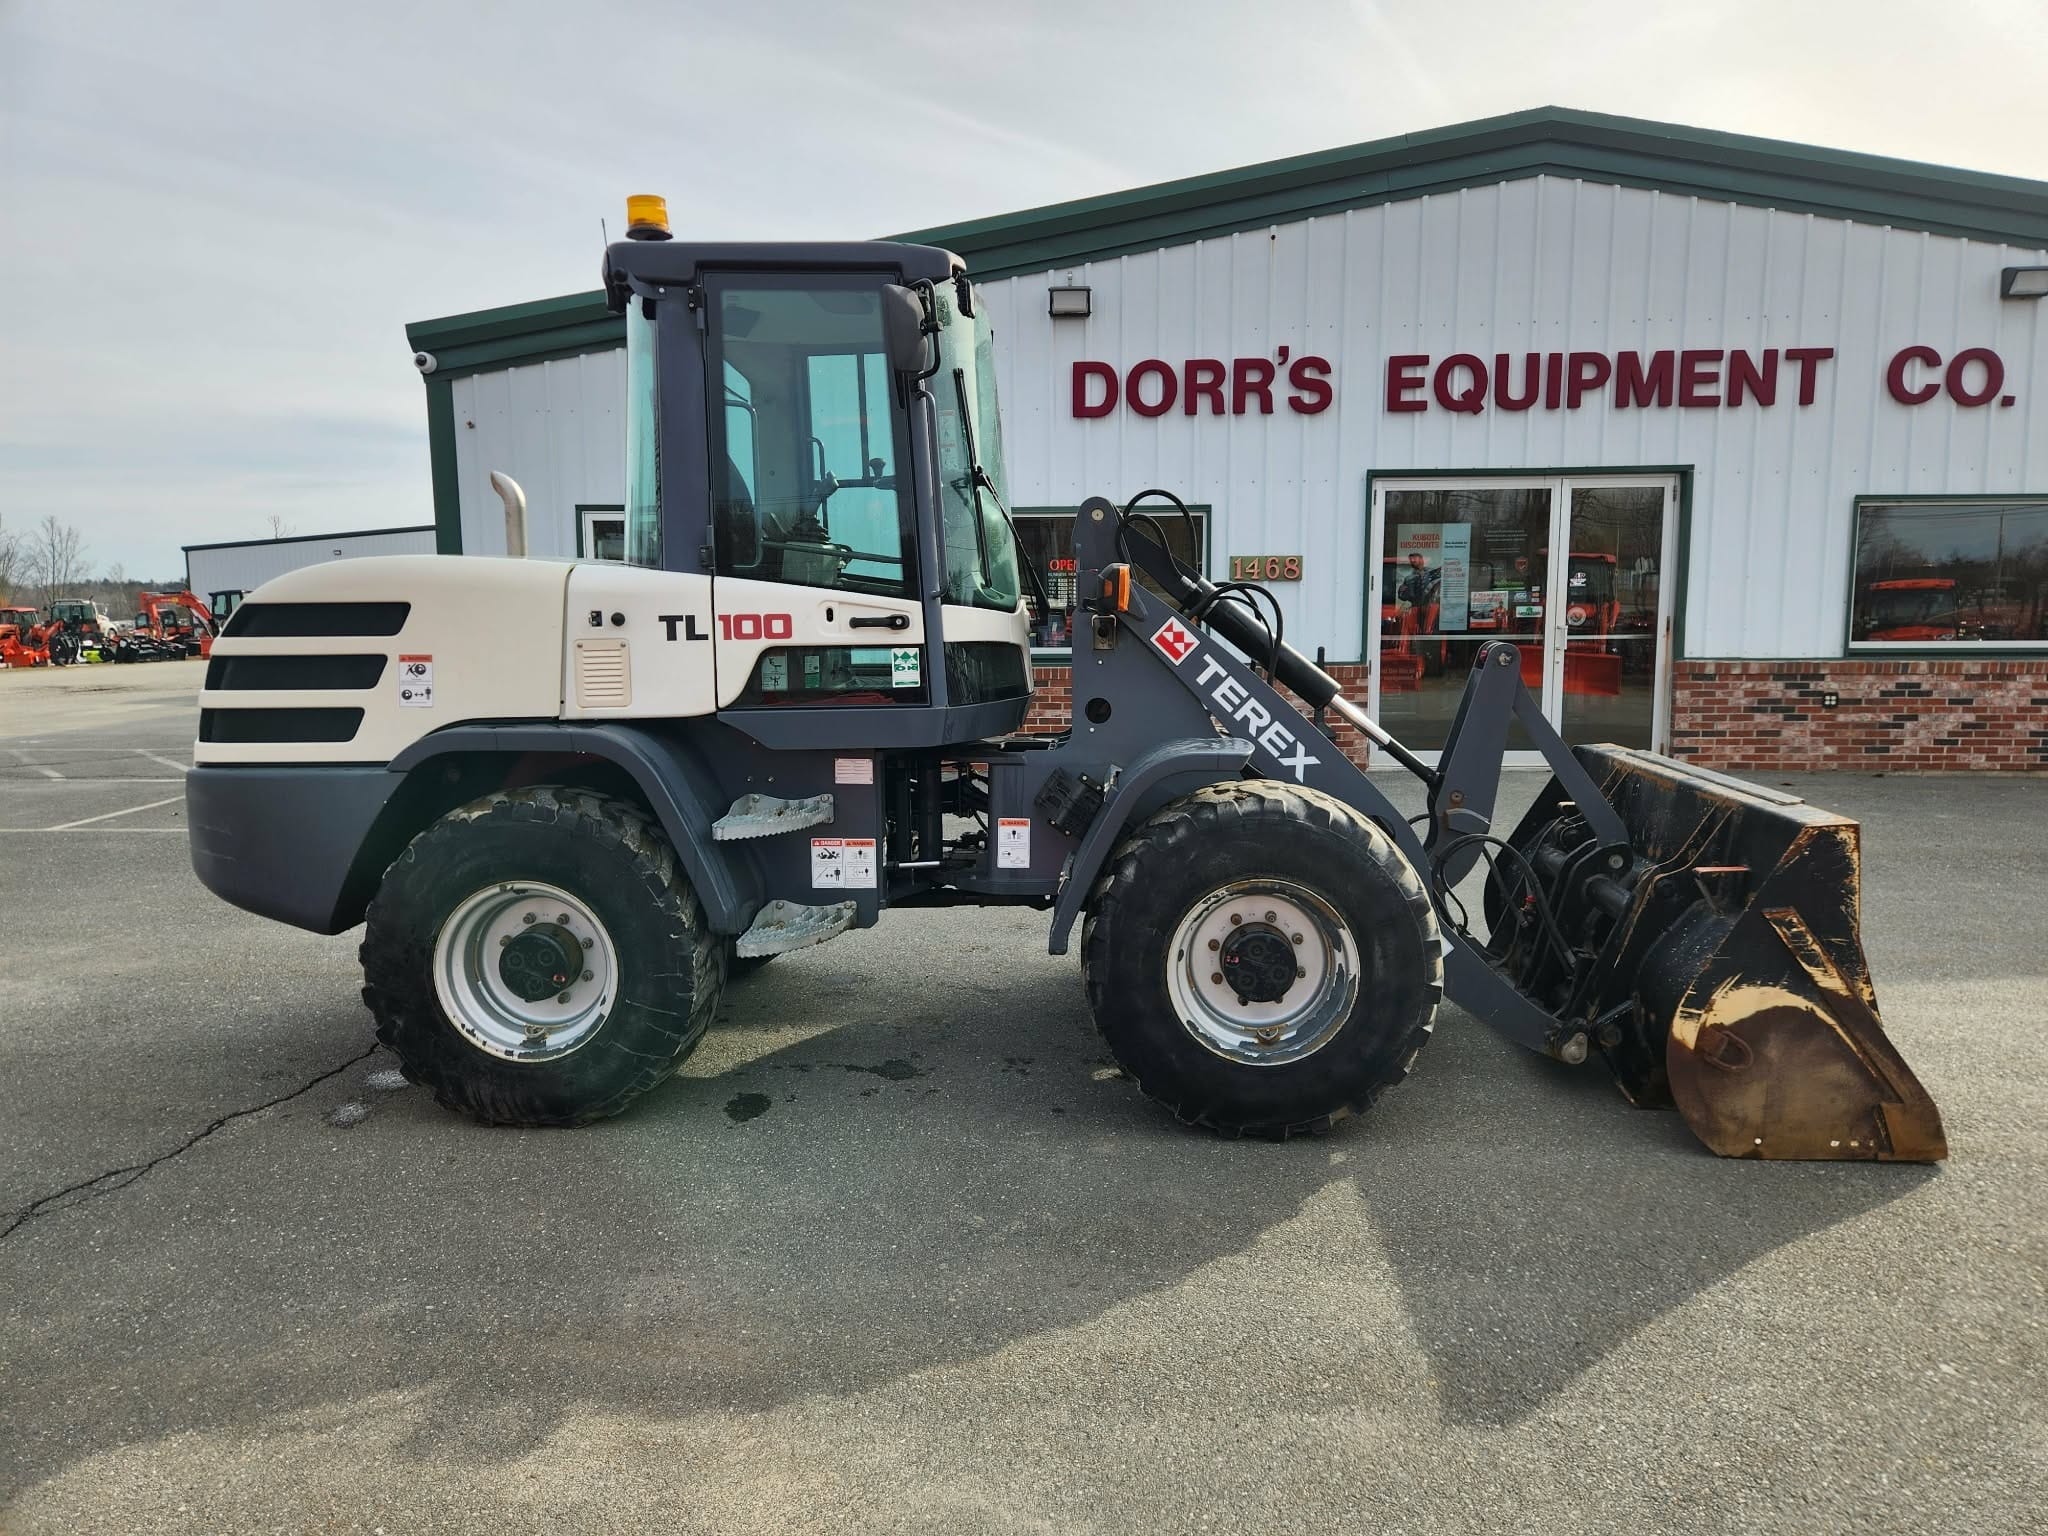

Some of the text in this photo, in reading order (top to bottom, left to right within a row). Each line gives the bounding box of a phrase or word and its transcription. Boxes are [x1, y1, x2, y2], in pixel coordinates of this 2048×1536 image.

[1072, 346, 2014, 419] DORR'S EQUIPMENT CO.
[1234, 556, 1300, 580] 1468
[1195, 653, 1321, 784] TEREX
